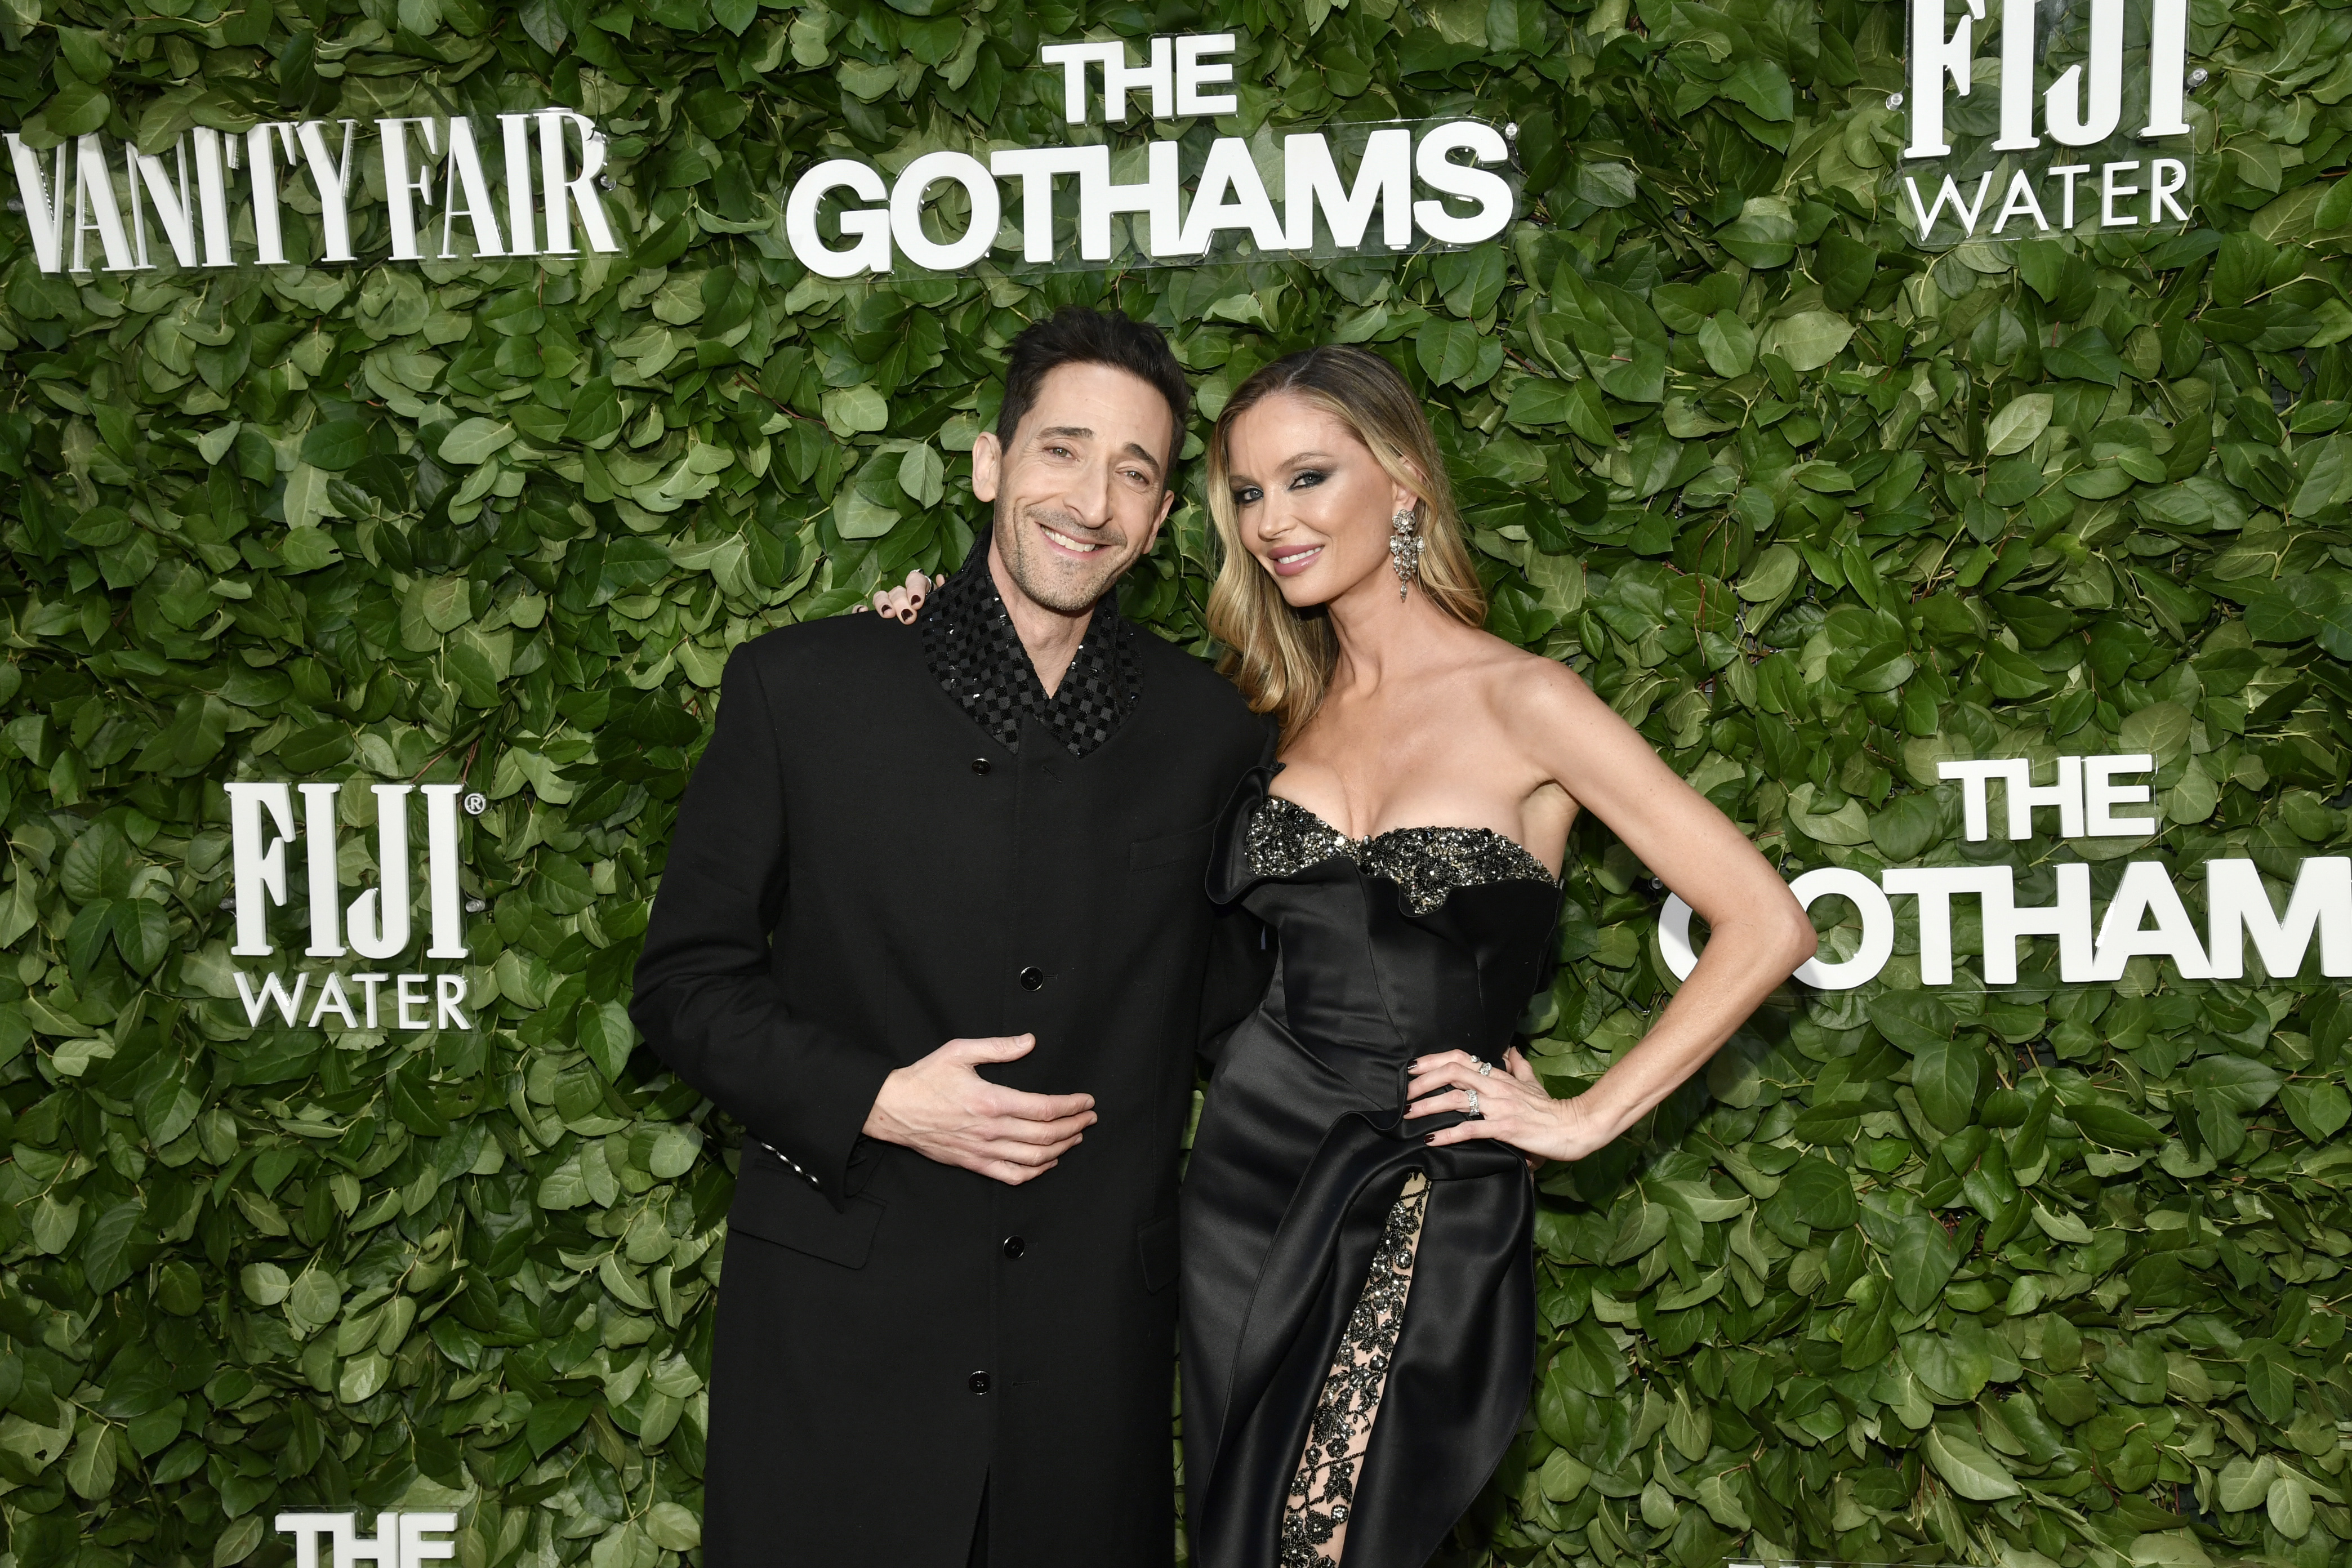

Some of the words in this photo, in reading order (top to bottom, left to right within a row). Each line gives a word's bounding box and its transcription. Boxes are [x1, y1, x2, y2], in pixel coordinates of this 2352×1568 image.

[1042, 33, 1237, 124] THE
[1904, 0, 2190, 159] FIJI
[3, 119, 358, 273] VANITY
[374, 107, 620, 261] FAIR
[786, 121, 1514, 278] GOTHAMS
[1905, 159, 2190, 242] WATER
[1937, 754, 2156, 842] THE
[233, 972, 472, 1030] WATER
[275, 1512, 458, 1568] THE
